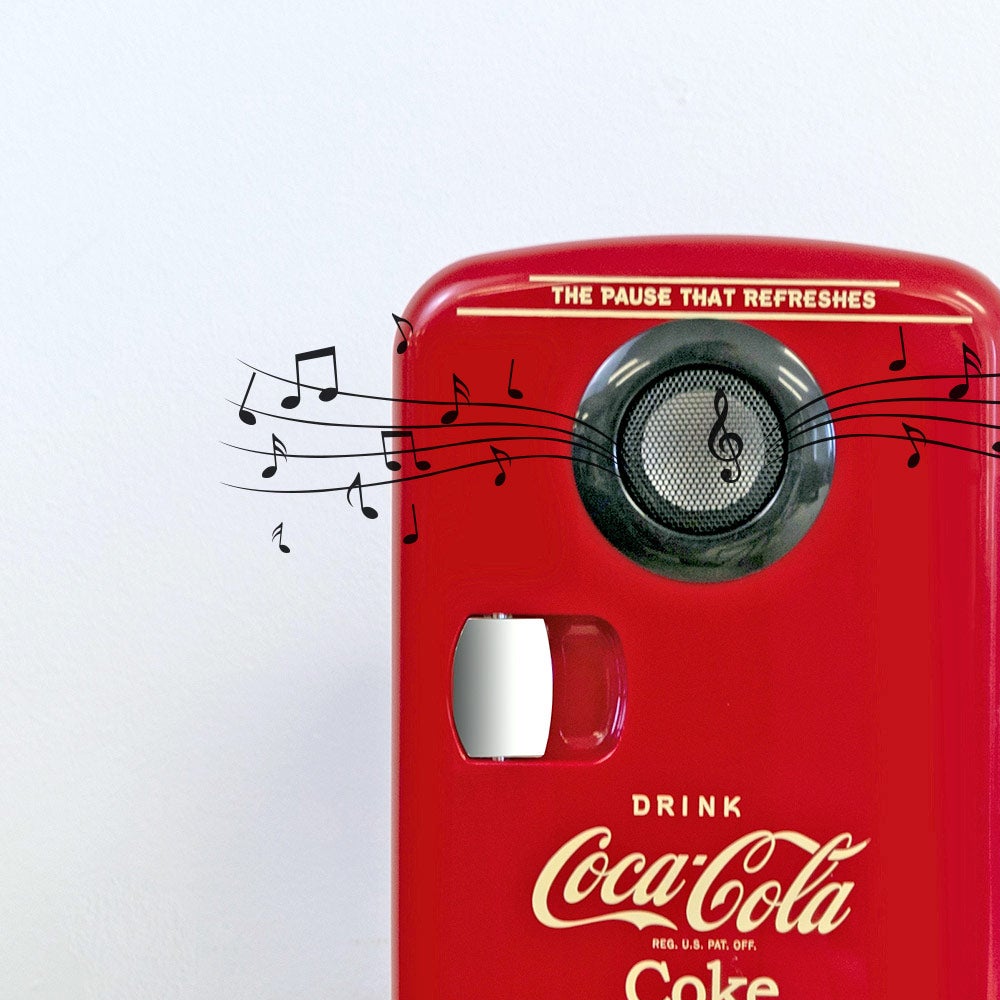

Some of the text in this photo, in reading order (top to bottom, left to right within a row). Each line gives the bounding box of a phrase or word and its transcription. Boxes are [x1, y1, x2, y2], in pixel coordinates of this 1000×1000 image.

[551, 285, 877, 310] THE PAUSE THAT REFRESHES
[631, 793, 743, 818] DRINK
[531, 826, 869, 935] Coca-Cola
[652, 937, 757, 951] REG. U.S. PAT. OFF.
